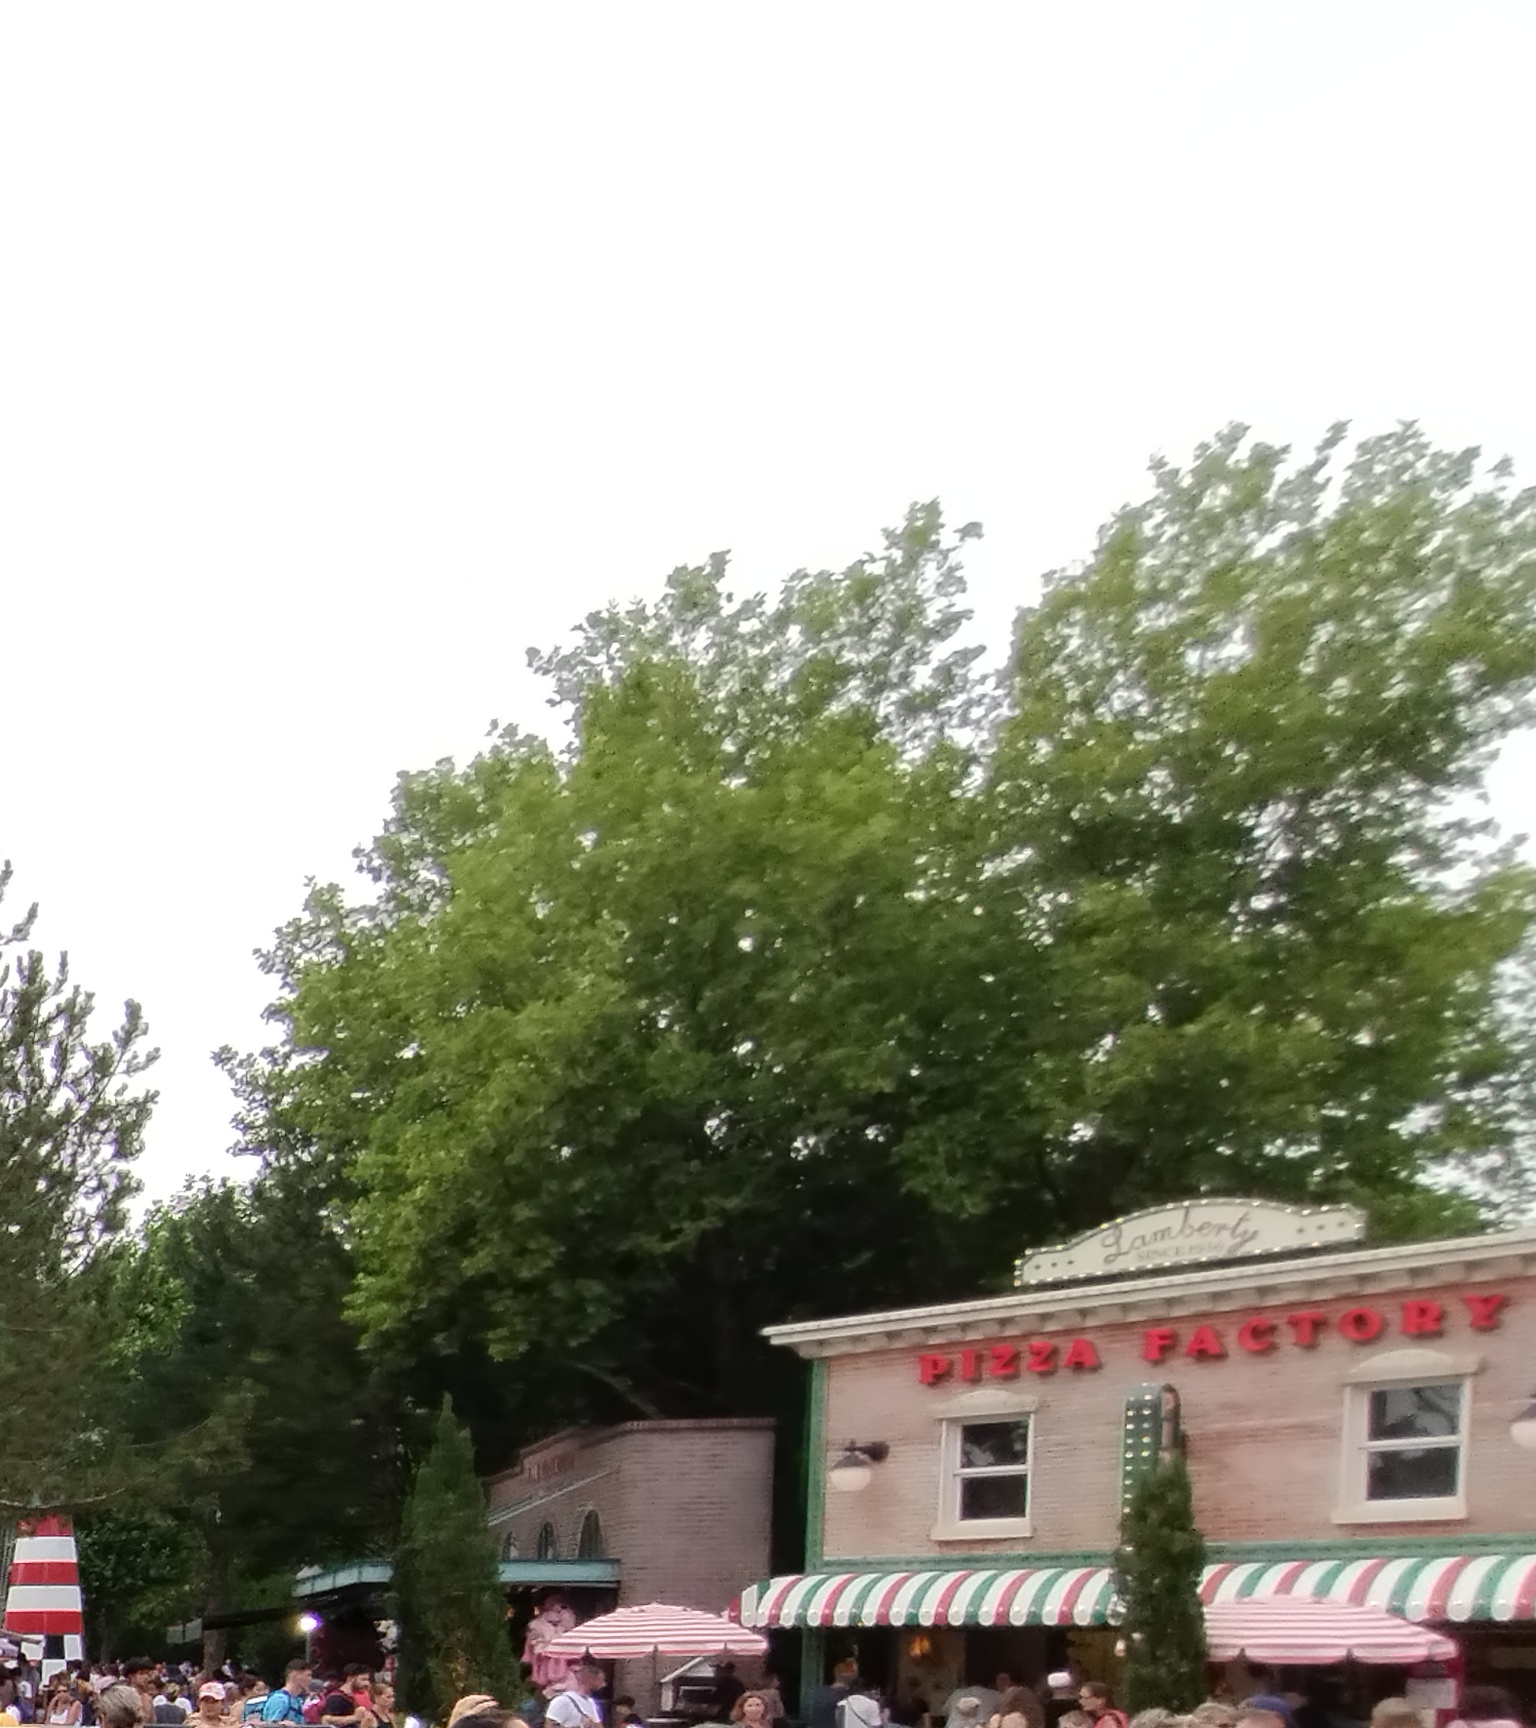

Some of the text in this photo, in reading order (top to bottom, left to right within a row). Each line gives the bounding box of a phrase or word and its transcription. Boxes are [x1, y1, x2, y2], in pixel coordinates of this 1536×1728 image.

[1100, 1206, 1260, 1264] Lamberty
[919, 1294, 1508, 1386] PIZZA FACTORY
